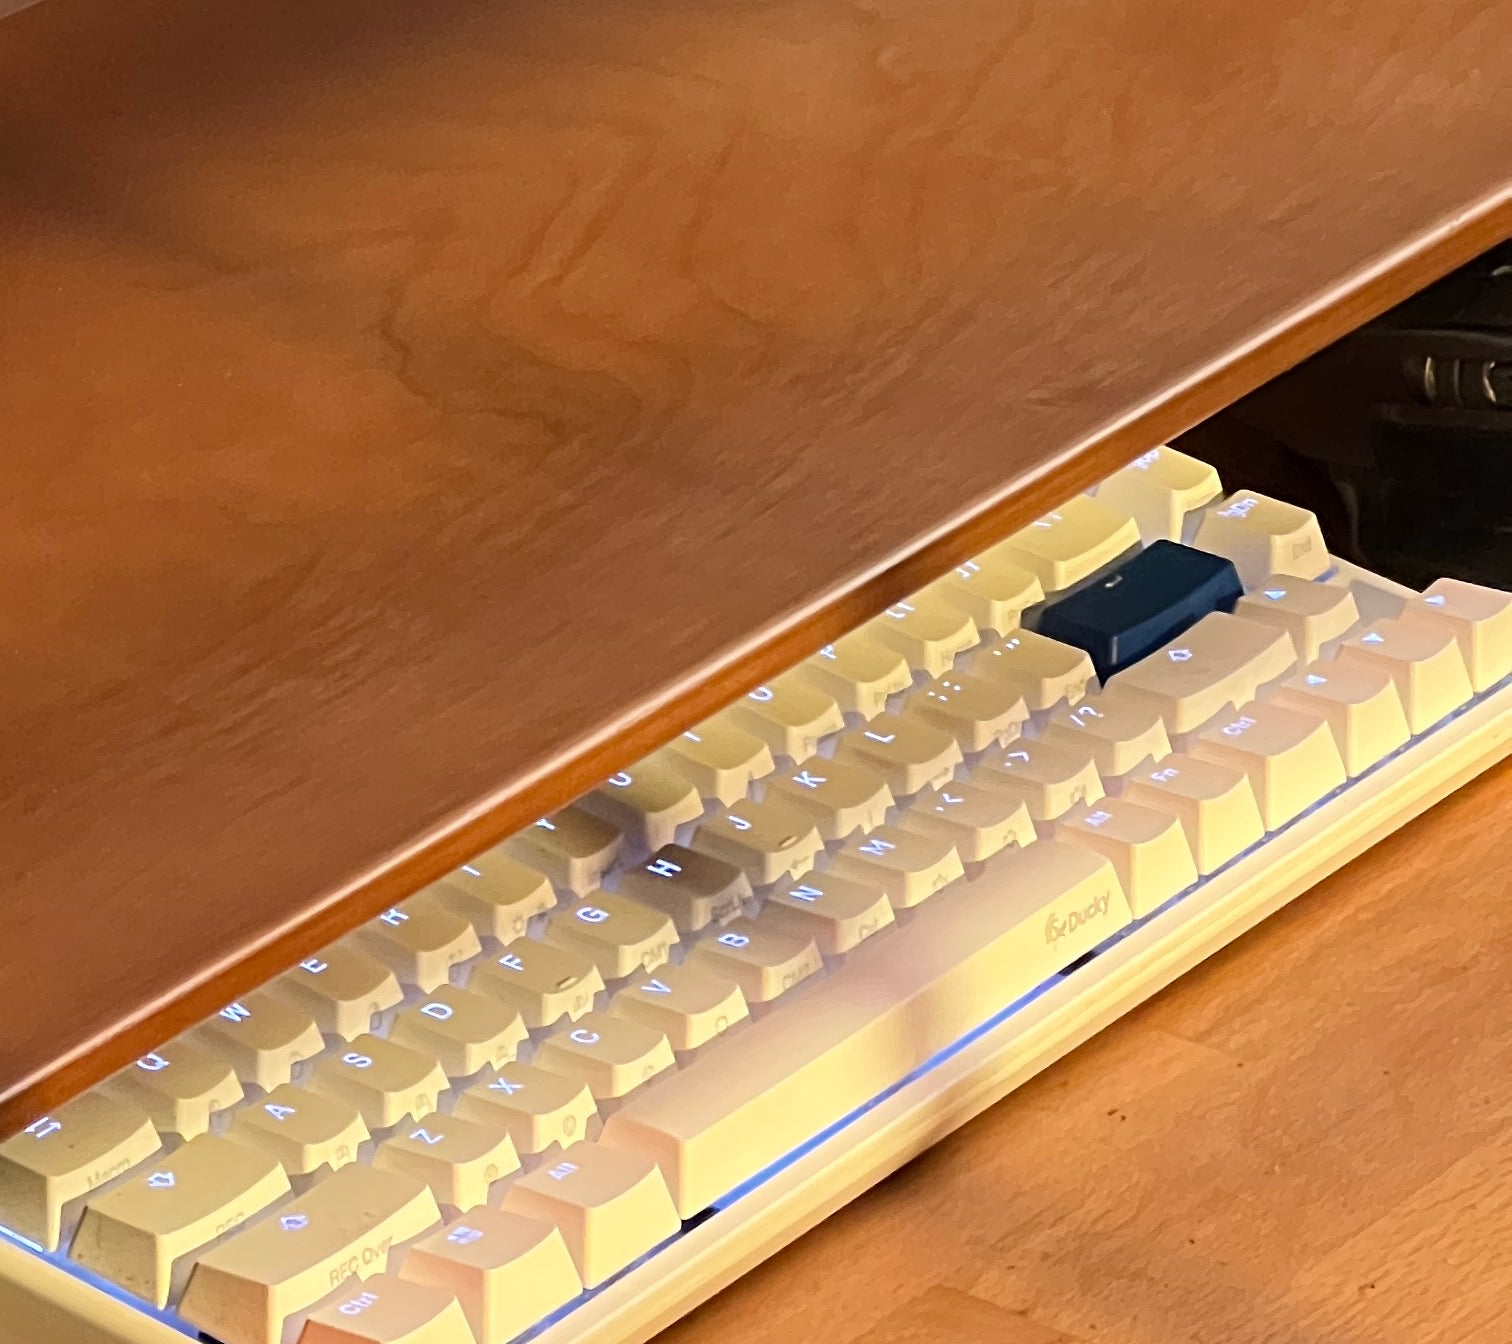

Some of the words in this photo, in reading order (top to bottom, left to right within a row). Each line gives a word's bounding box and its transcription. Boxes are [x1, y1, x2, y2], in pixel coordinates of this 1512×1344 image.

[864, 731, 896, 743] L
[792, 771, 828, 789] K
[728, 815, 752, 831] J
[858, 838, 896, 856] M
[646, 858, 683, 878] H
[789, 884, 824, 902] N
[576, 906, 610, 923] G
[1069, 889, 1111, 933] Ducky
[718, 932, 751, 948] B
[299, 958, 328, 974] E
[498, 953, 524, 972] F
[641, 978, 672, 994] V
[218, 1001, 252, 1023] W
[420, 1002, 454, 1020] D
[571, 1029, 600, 1044] C
[135, 1052, 171, 1072] Q
[343, 1052, 373, 1068] S
[488, 1077, 525, 1095] X
[264, 1103, 297, 1121] A
[409, 1128, 444, 1145] Z
